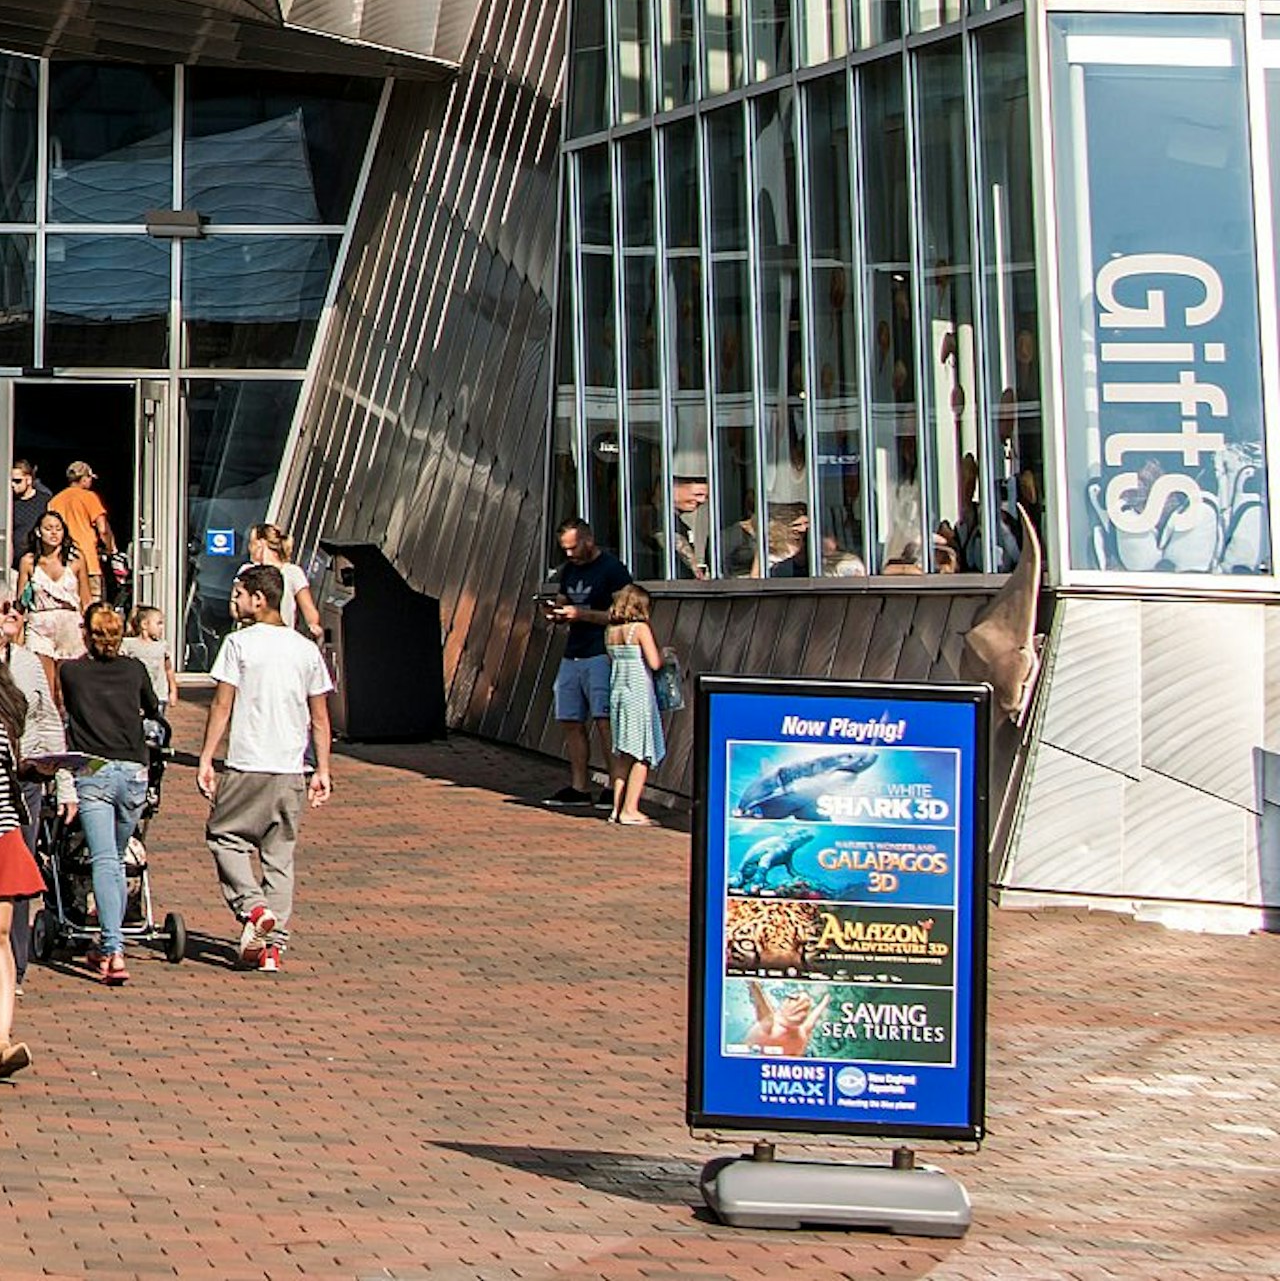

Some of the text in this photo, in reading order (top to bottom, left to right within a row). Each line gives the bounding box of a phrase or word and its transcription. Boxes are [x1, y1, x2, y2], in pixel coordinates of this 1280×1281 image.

[1094, 252, 1226, 535] Gifts
[781, 715, 907, 742] Now Playing!
[887, 783, 933, 798] WHITE
[815, 794, 950, 821] SHARK 3D
[876, 842, 937, 853] WONDERLAND
[817, 848, 949, 875] GALAPAGOS
[867, 871, 899, 894] 3D
[816, 912, 931, 951] AMAZON
[842, 940, 950, 957] ADVENTURE 3D
[840, 1002, 928, 1026] SAVING
[822, 1021, 945, 1043] SEA TURTLES
[761, 1064, 826, 1081] SIMONS
[868, 1073, 916, 1085] New England
[760, 1079, 825, 1097] IMAX
